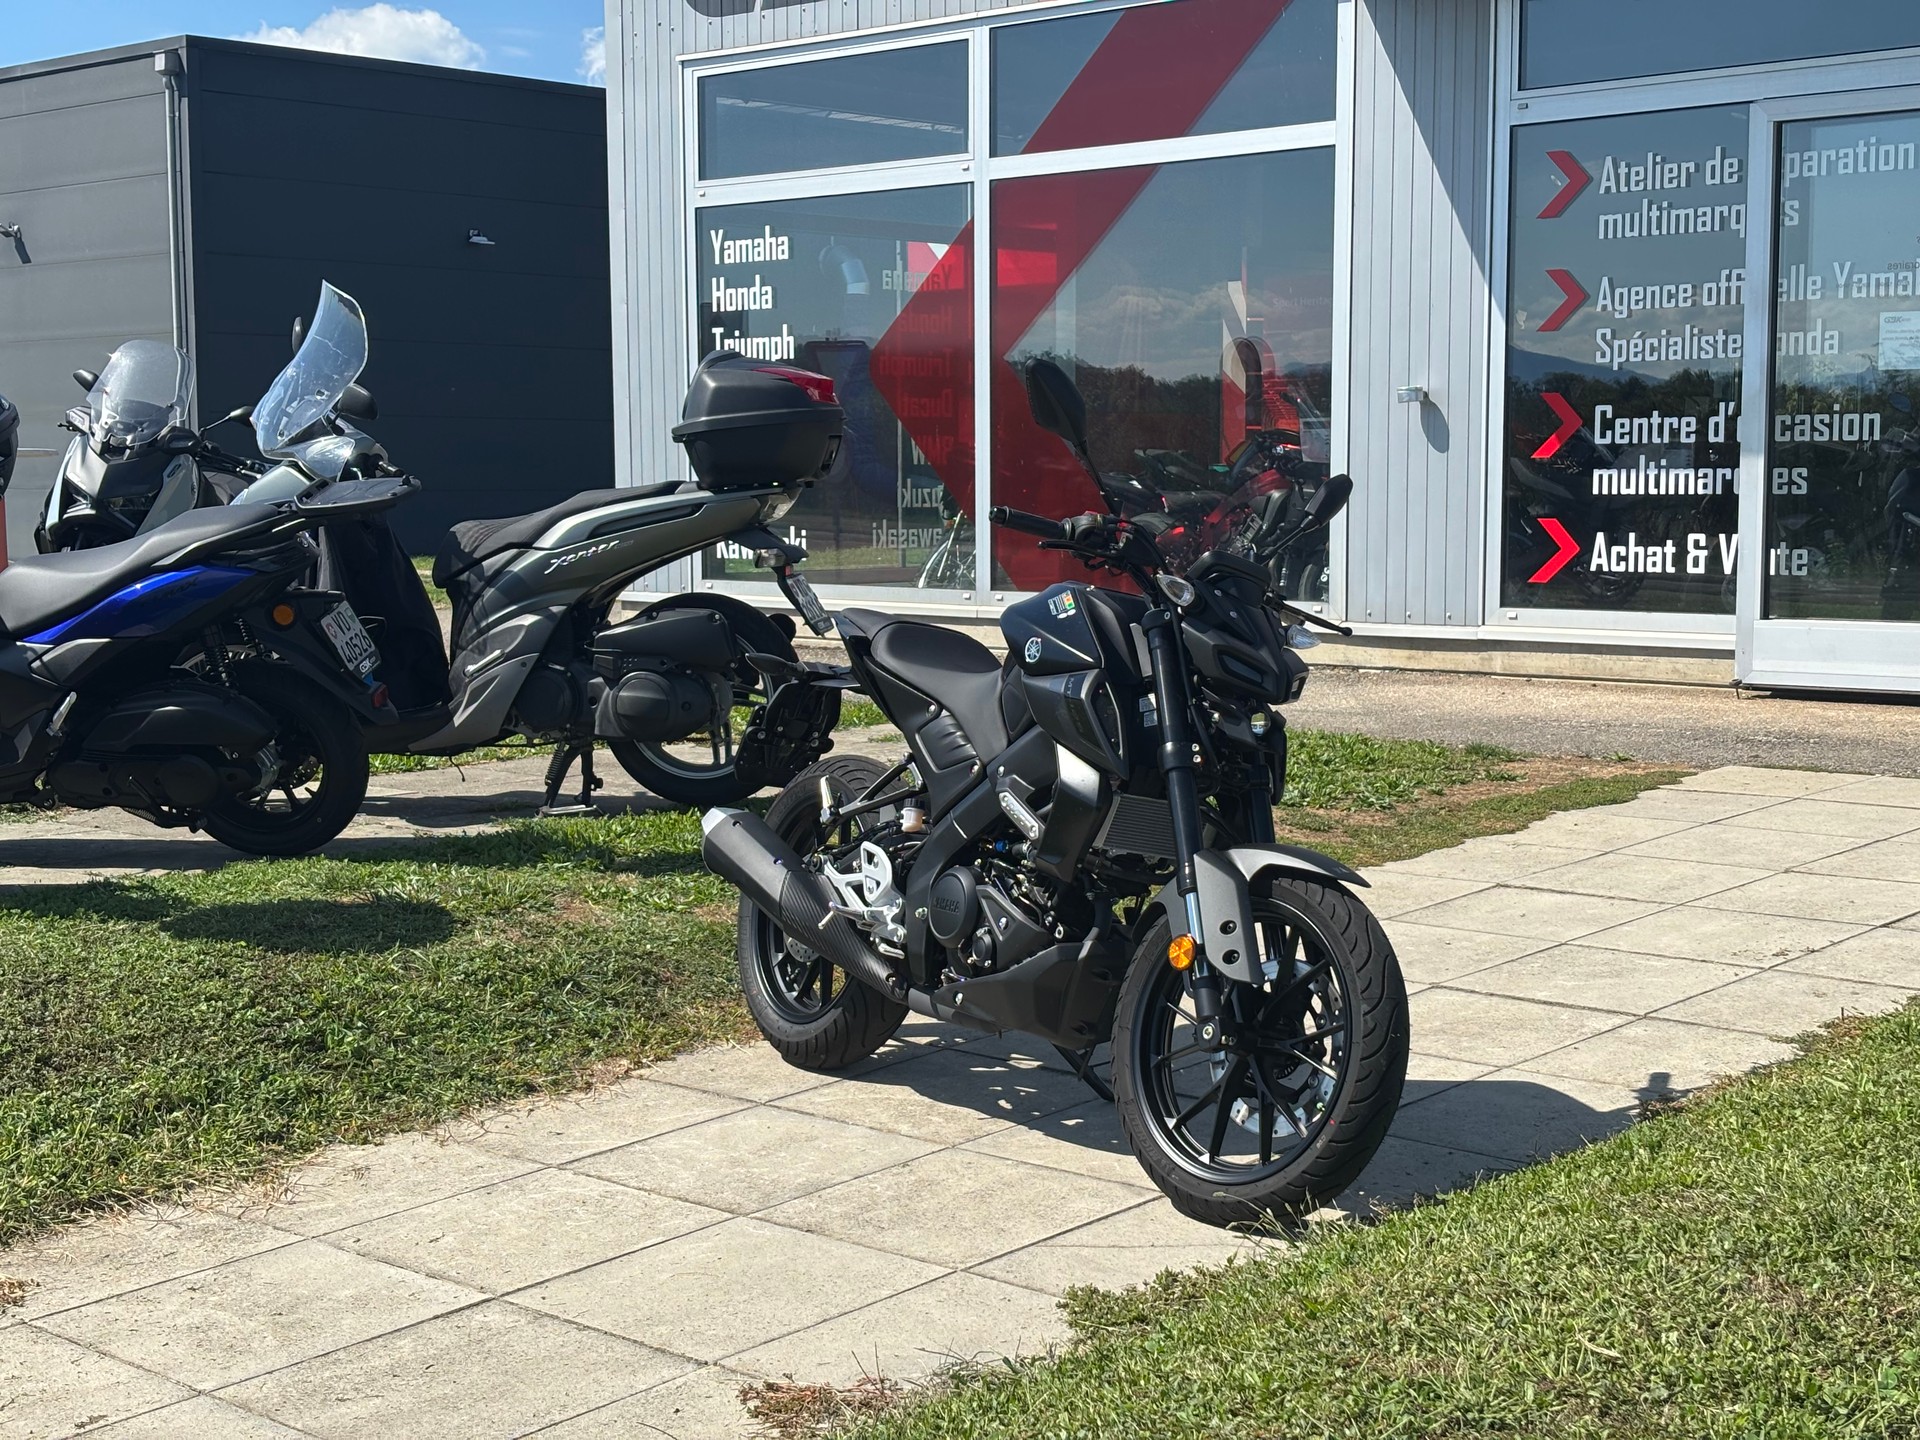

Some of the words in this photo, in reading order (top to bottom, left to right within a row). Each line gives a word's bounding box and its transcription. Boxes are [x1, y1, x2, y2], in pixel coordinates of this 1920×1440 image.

[1599, 151, 1695, 194] Atelier
[1705, 146, 1739, 186] de
[1784, 136, 1915, 187] paration
[1599, 198, 1800, 239] multimarqs
[710, 225, 789, 264] Yamaha
[711, 274, 773, 312] Honda
[1596, 276, 1693, 318] Agence
[1833, 258, 1920, 299] Yama
[1596, 324, 1743, 371] Spécialiste
[1777, 318, 1839, 356] onda
[1594, 404, 1697, 444] Centre
[1590, 532, 1676, 574] Achat
[1687, 533, 1708, 574] &
[331, 611, 351, 635] VD
[341, 628, 372, 665] 40526
